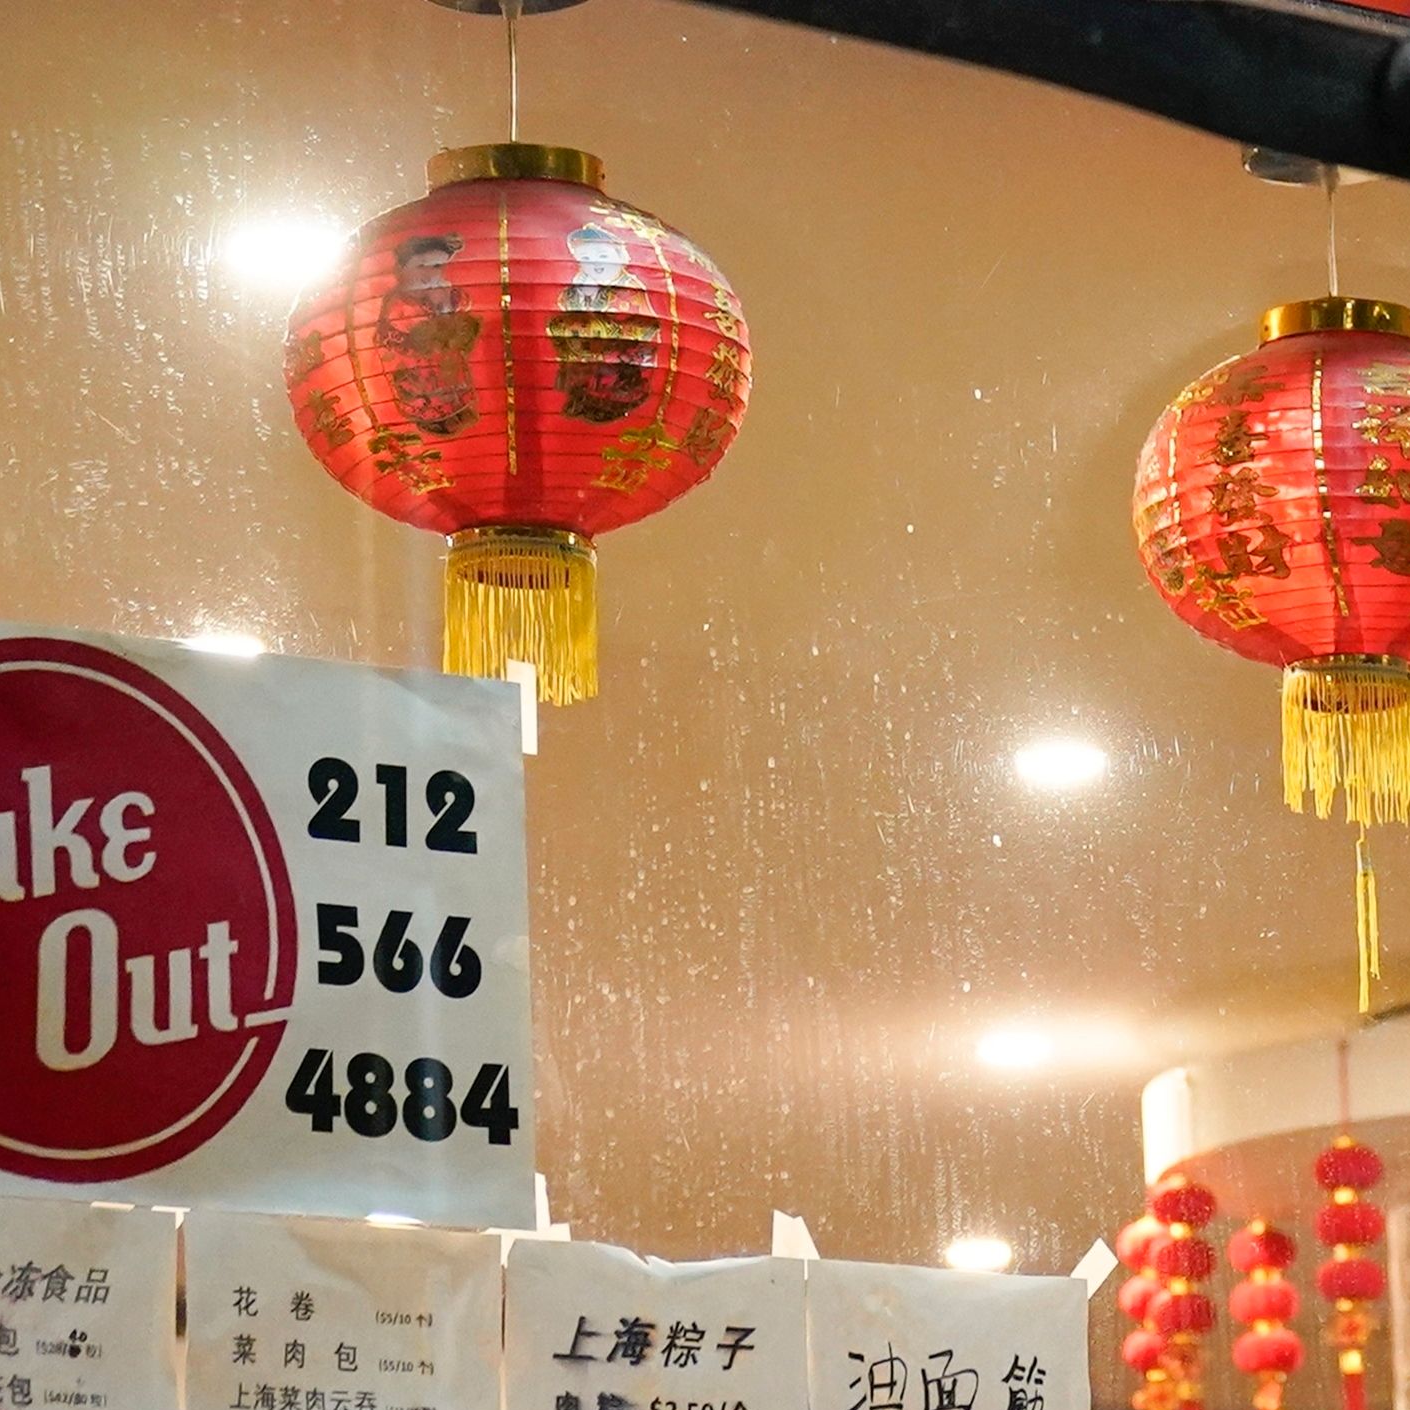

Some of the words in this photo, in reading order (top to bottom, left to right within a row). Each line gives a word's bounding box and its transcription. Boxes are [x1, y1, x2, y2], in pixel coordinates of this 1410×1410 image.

[307, 757, 478, 854] 212
[36, 908, 239, 1072] Out
[316, 903, 482, 998] 566
[285, 1048, 519, 1145] 4884
[232, 1285, 316, 1322] 花卷
[552, 1316, 756, 1371] 上海粽子
[232, 1333, 359, 1373] 菜肉包
